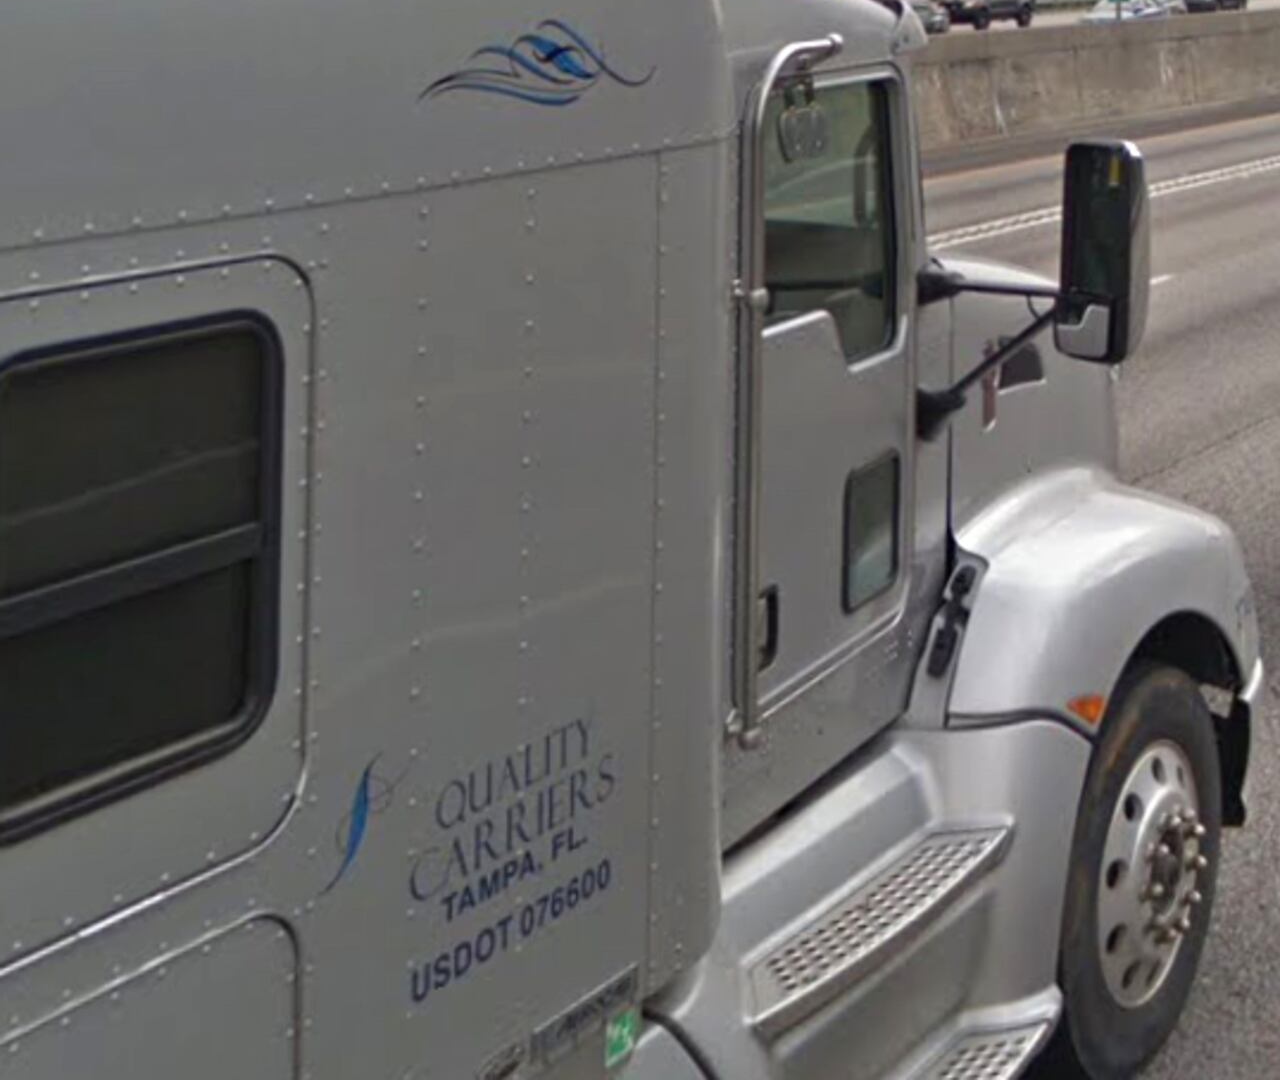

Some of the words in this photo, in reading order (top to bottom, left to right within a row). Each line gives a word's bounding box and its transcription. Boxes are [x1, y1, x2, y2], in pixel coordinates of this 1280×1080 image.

[408, 752, 616, 903] CARRIERS
[434, 717, 592, 831] QUALITY
[410, 919, 514, 1003] USDOT
[519, 857, 613, 937] 076600
